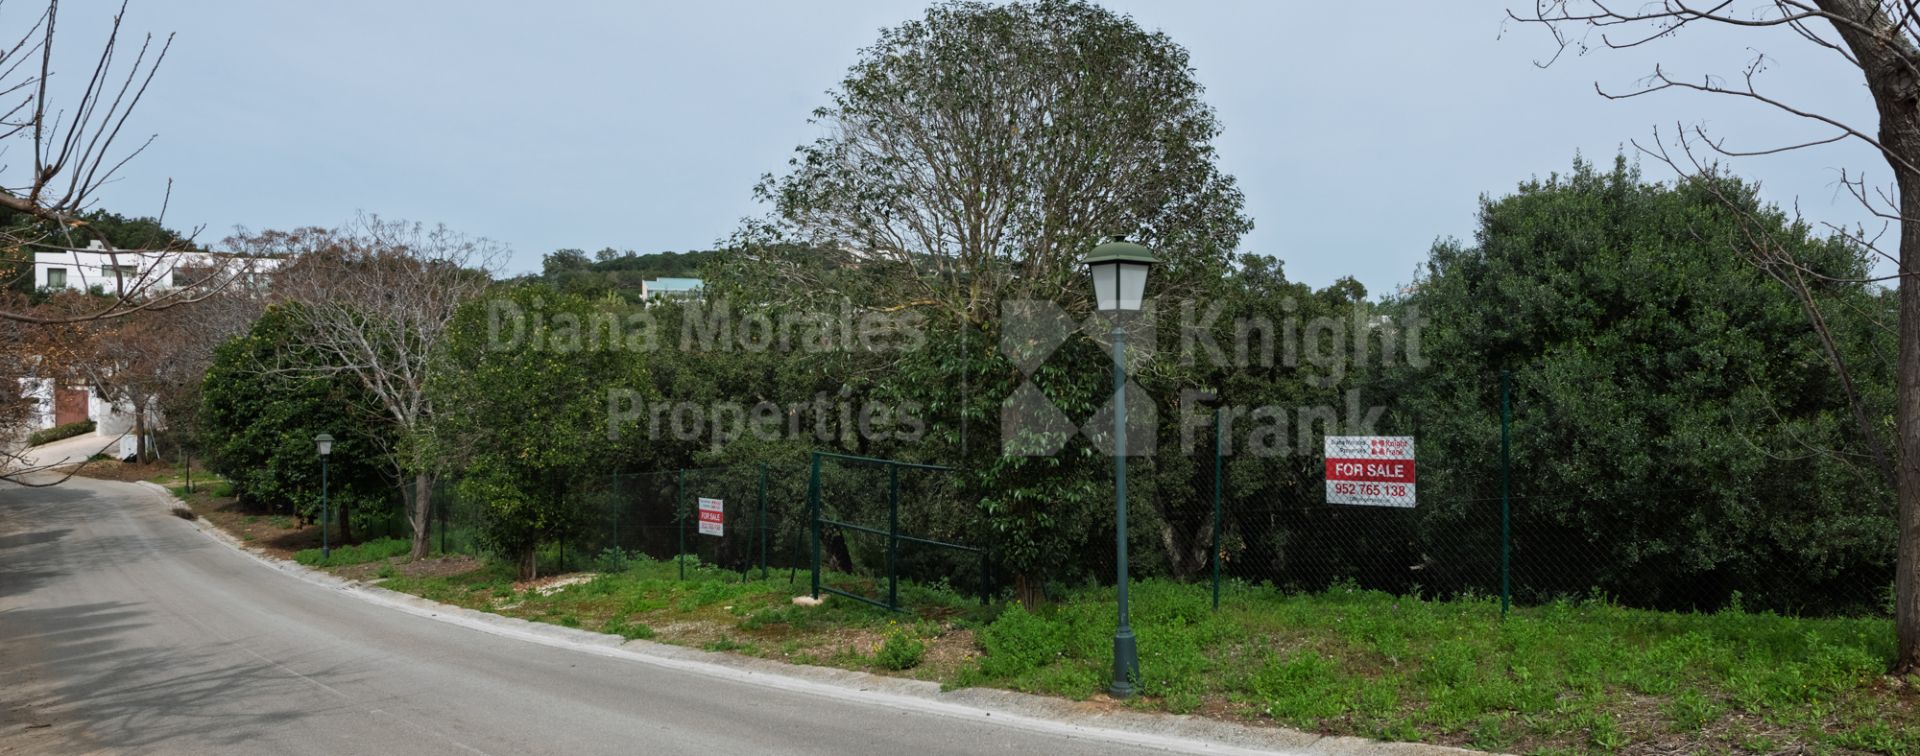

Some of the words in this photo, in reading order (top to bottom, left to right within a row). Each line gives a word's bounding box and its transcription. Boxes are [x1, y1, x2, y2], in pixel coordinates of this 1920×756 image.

[1335, 463, 1363, 477] FOR
[1367, 464, 1404, 478] SALE
[1335, 483, 1356, 494] 952
[1359, 484, 1380, 496] 765
[1384, 485, 1406, 497] 138
